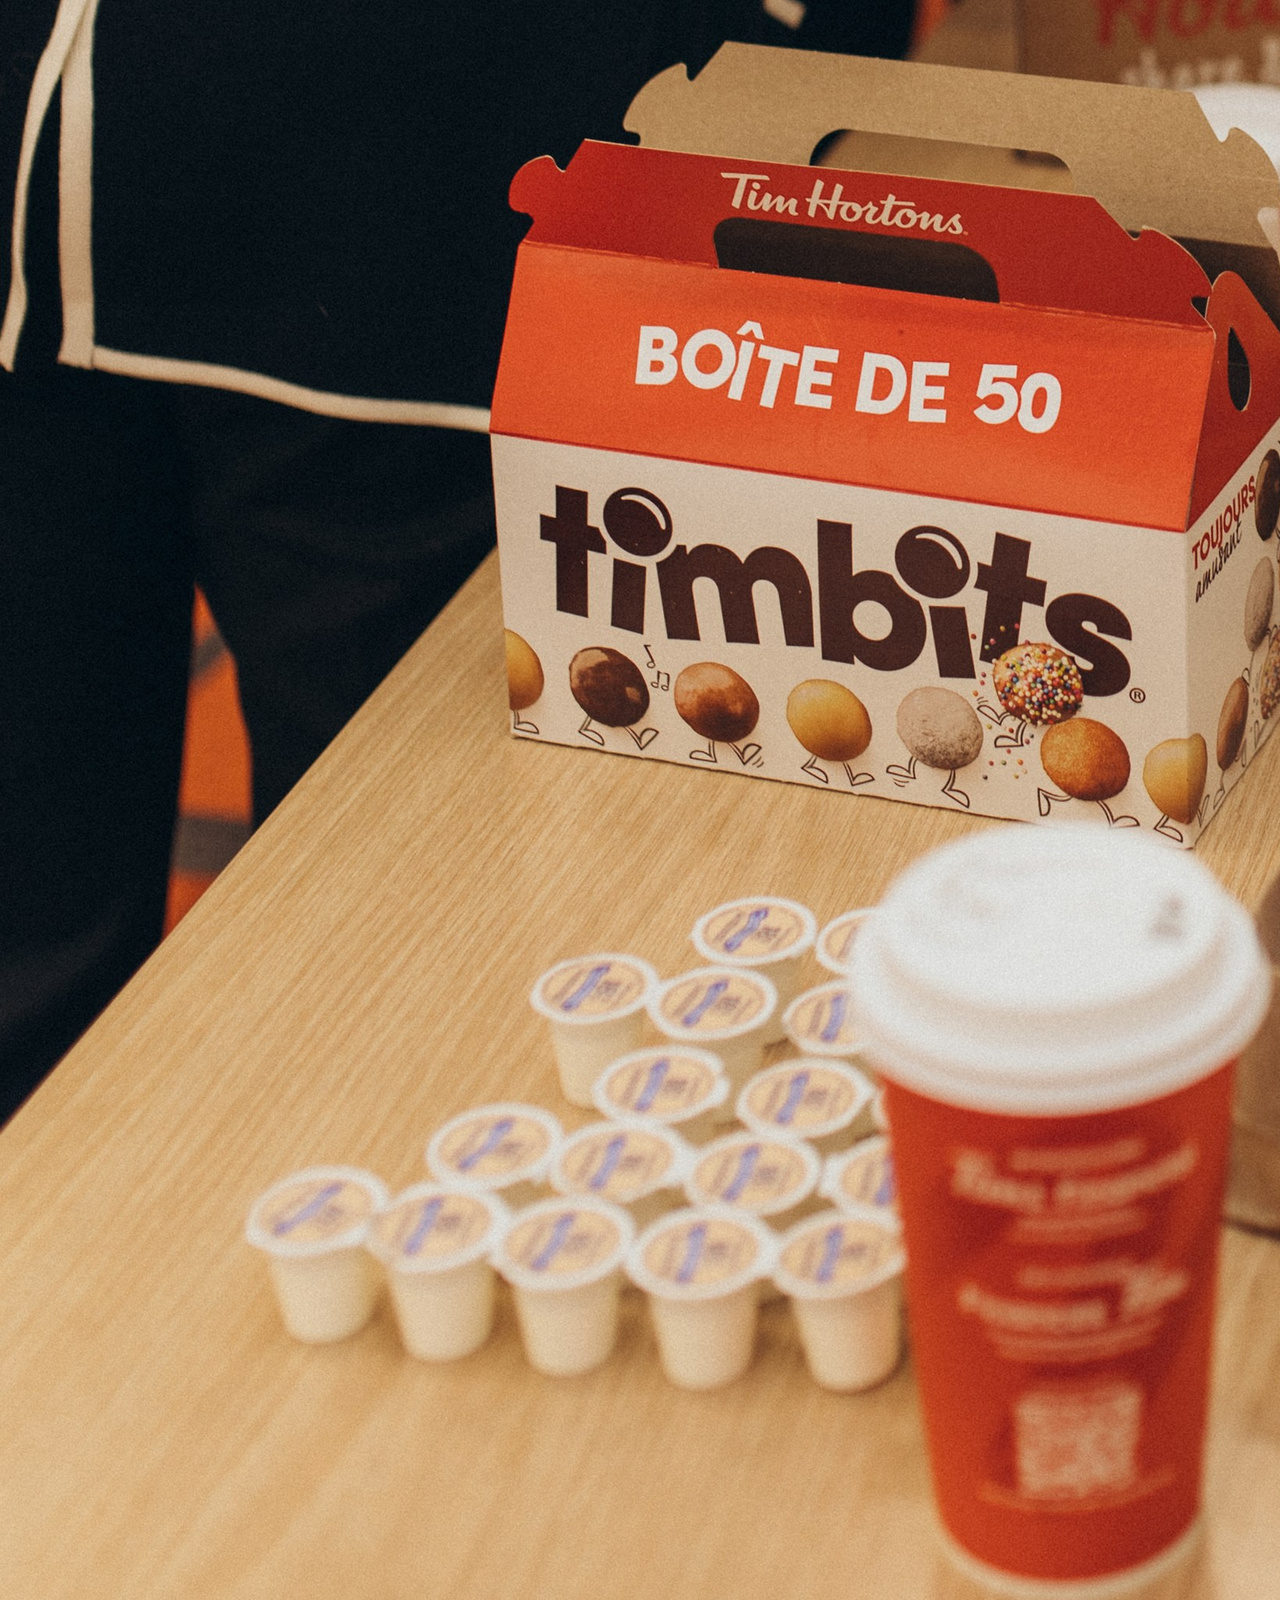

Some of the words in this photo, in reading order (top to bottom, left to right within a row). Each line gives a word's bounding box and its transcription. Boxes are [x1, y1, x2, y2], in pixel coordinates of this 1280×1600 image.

[719, 171, 799, 216] Tim
[805, 178, 964, 236] Hortons
[635, 320, 840, 410] BOÎTE
[855, 351, 950, 424] DE
[973, 363, 1062, 434] 50
[1191, 475, 1257, 571] TOUJOURS
[1195, 519, 1243, 604] amusant
[539, 484, 1133, 698] timbits
